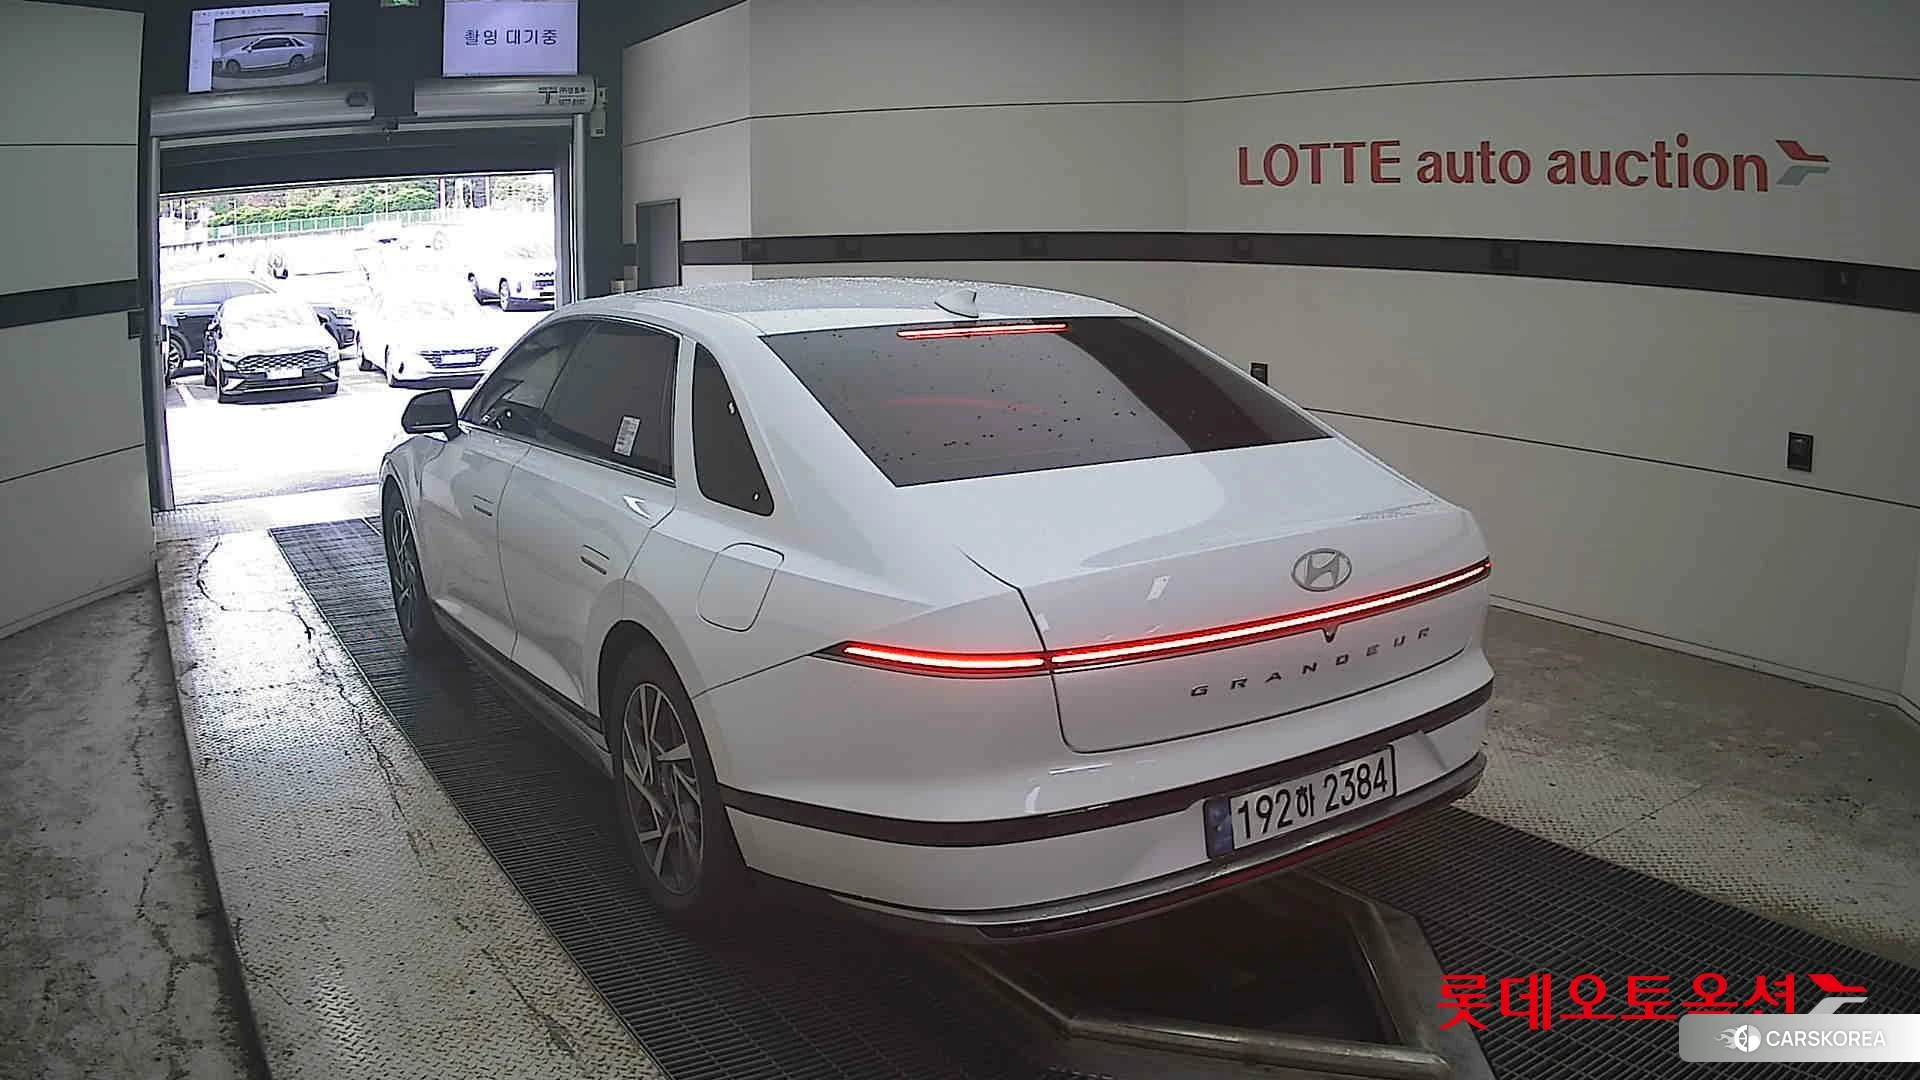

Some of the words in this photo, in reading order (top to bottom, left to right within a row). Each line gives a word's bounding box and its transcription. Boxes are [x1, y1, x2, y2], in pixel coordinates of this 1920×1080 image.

[464, 29, 498, 46] 촬영
[506, 29, 558, 46] 대기중
[1238, 140, 1401, 187] LOTTE
[1416, 140, 1532, 185] auto
[1547, 132, 1769, 192] auction
[1190, 627, 1431, 697] GRANDEUR
[1237, 783, 1315, 839] 192하
[1323, 757, 1389, 813] 2384
